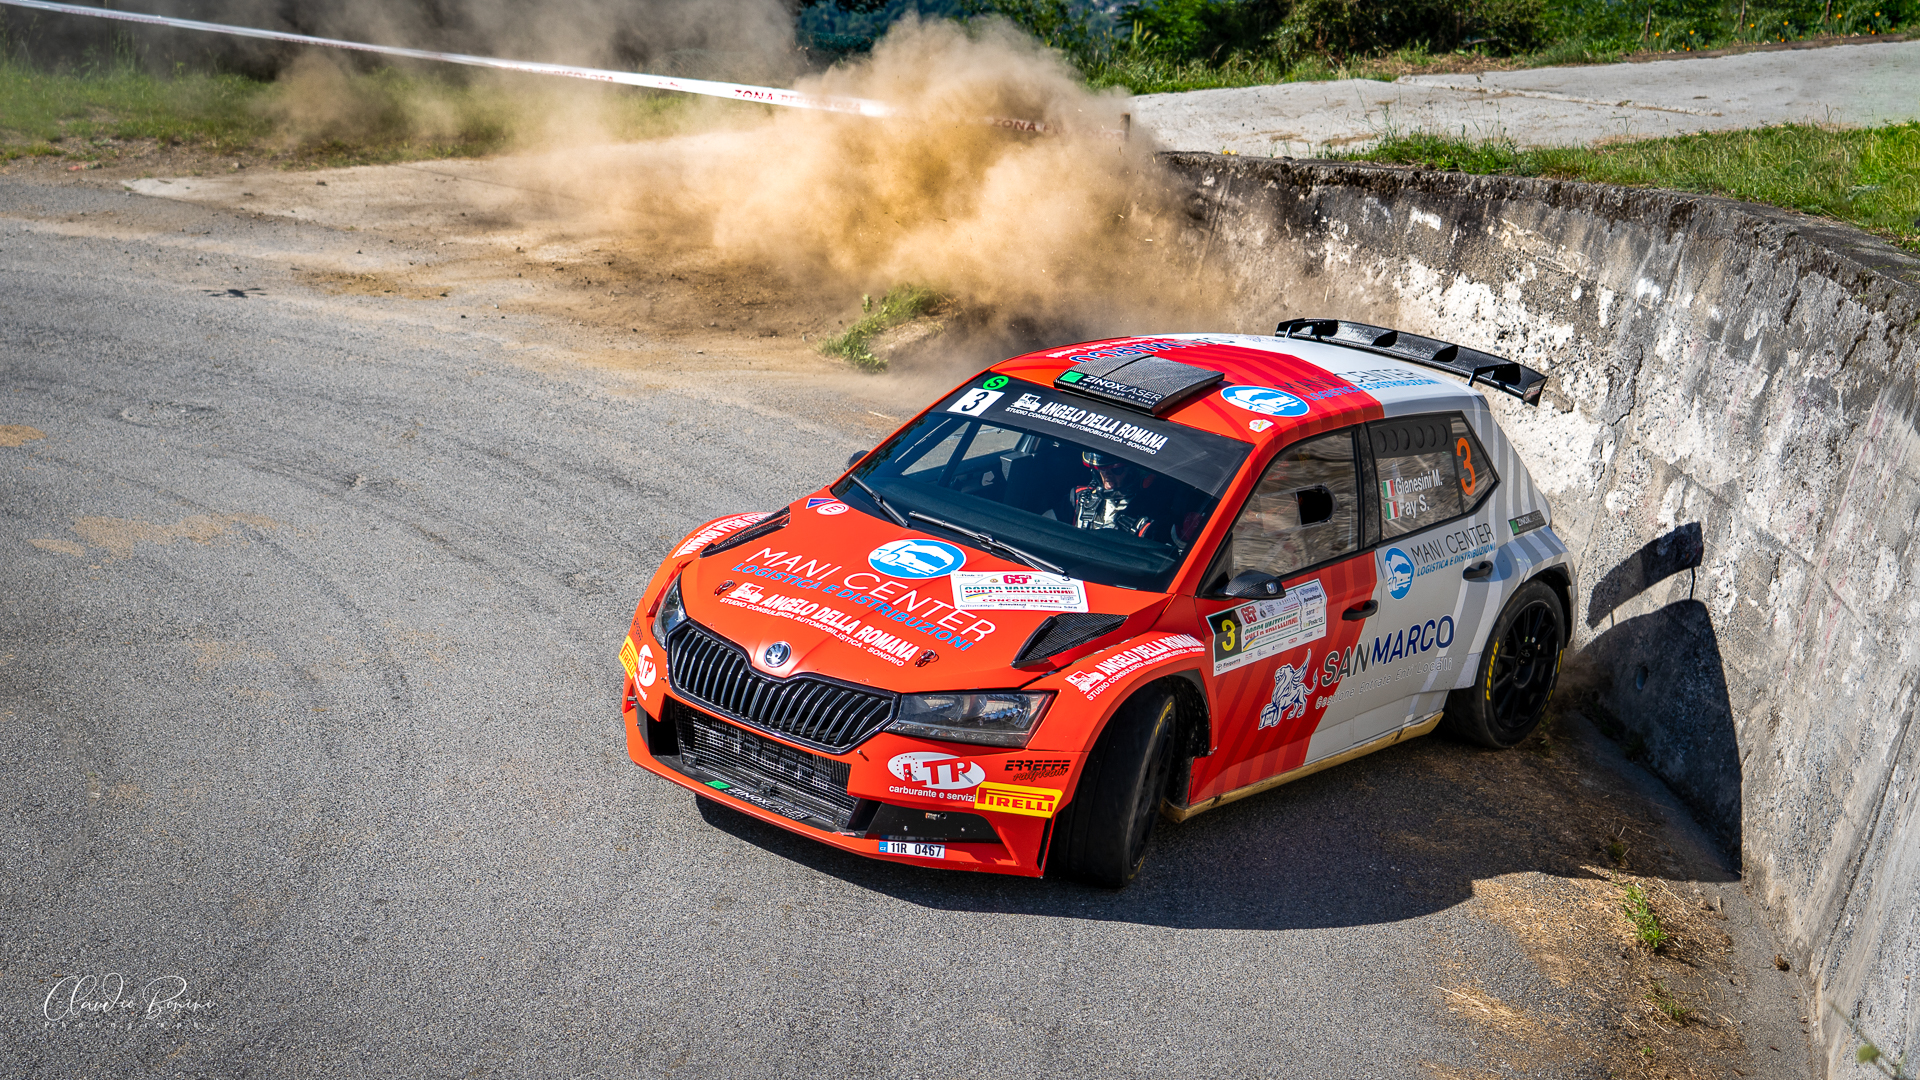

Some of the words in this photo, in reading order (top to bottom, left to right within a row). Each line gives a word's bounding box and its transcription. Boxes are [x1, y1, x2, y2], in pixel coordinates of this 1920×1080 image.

[735, 89, 773, 101] ZONA
[987, 377, 1000, 389] S
[1083, 375, 1163, 401] ZINOXLASER
[1091, 384, 1109, 393] give
[1139, 396, 1156, 406] steel
[961, 391, 987, 412] 3
[1005, 406, 1027, 417] STUDIO
[1027, 409, 1067, 427] CONSULENZA
[1067, 421, 1123, 444] AUTOMOBILISTICA
[1126, 440, 1157, 456] SONDRIO
[1038, 401, 1085, 424] ANGELO
[1083, 412, 1117, 434] DELLA
[1115, 420, 1170, 450] ROMANA
[1395, 470, 1432, 496] Gianesini
[1431, 468, 1443, 487] M.
[1456, 437, 1476, 496] 3
[1398, 499, 1417, 519] Fay
[1418, 493, 1430, 512] S.
[1410, 534, 1445, 566] MANI
[1445, 522, 1495, 554] CENTER
[1416, 558, 1449, 577] LOGISTICA
[1453, 541, 1496, 565] DISTRIBUZIONI
[732, 562, 821, 590] LOGISTICA
[822, 583, 837, 594] E
[835, 588, 975, 651] DISTRIBUZIONI
[745, 547, 842, 581] MANI
[843, 572, 997, 642] CENTER
[720, 597, 747, 609] STUDIO
[746, 602, 795, 622] CONSULENZA
[795, 615, 863, 649] AUTOMOBILISTICA
[867, 645, 905, 667] SONDRIO
[759, 592, 818, 620] ANGELO
[816, 604, 862, 635] DELLA
[852, 623, 920, 662] ROMANA
[1221, 619, 1236, 651] 3
[1095, 650, 1143, 677] ANGELO
[1130, 638, 1172, 660] DELLA
[1321, 614, 1455, 687] SANMARCO
[1086, 680, 1110, 701] STUDIO
[1109, 662, 1145, 684] CONSULENZA
[1315, 687, 1355, 710] Gestione
[1358, 672, 1392, 695] Entrate
[1394, 664, 1414, 681] Enti
[1416, 657, 1453, 674] Locali
[902, 757, 972, 788] LTR
[888, 784, 937, 799] carburante
[938, 791, 945, 799] e
[946, 791, 976, 803] servizi
[977, 787, 1056, 812] PIRELLI
[891, 843, 907, 854] 11R
[914, 844, 942, 857] 0467
